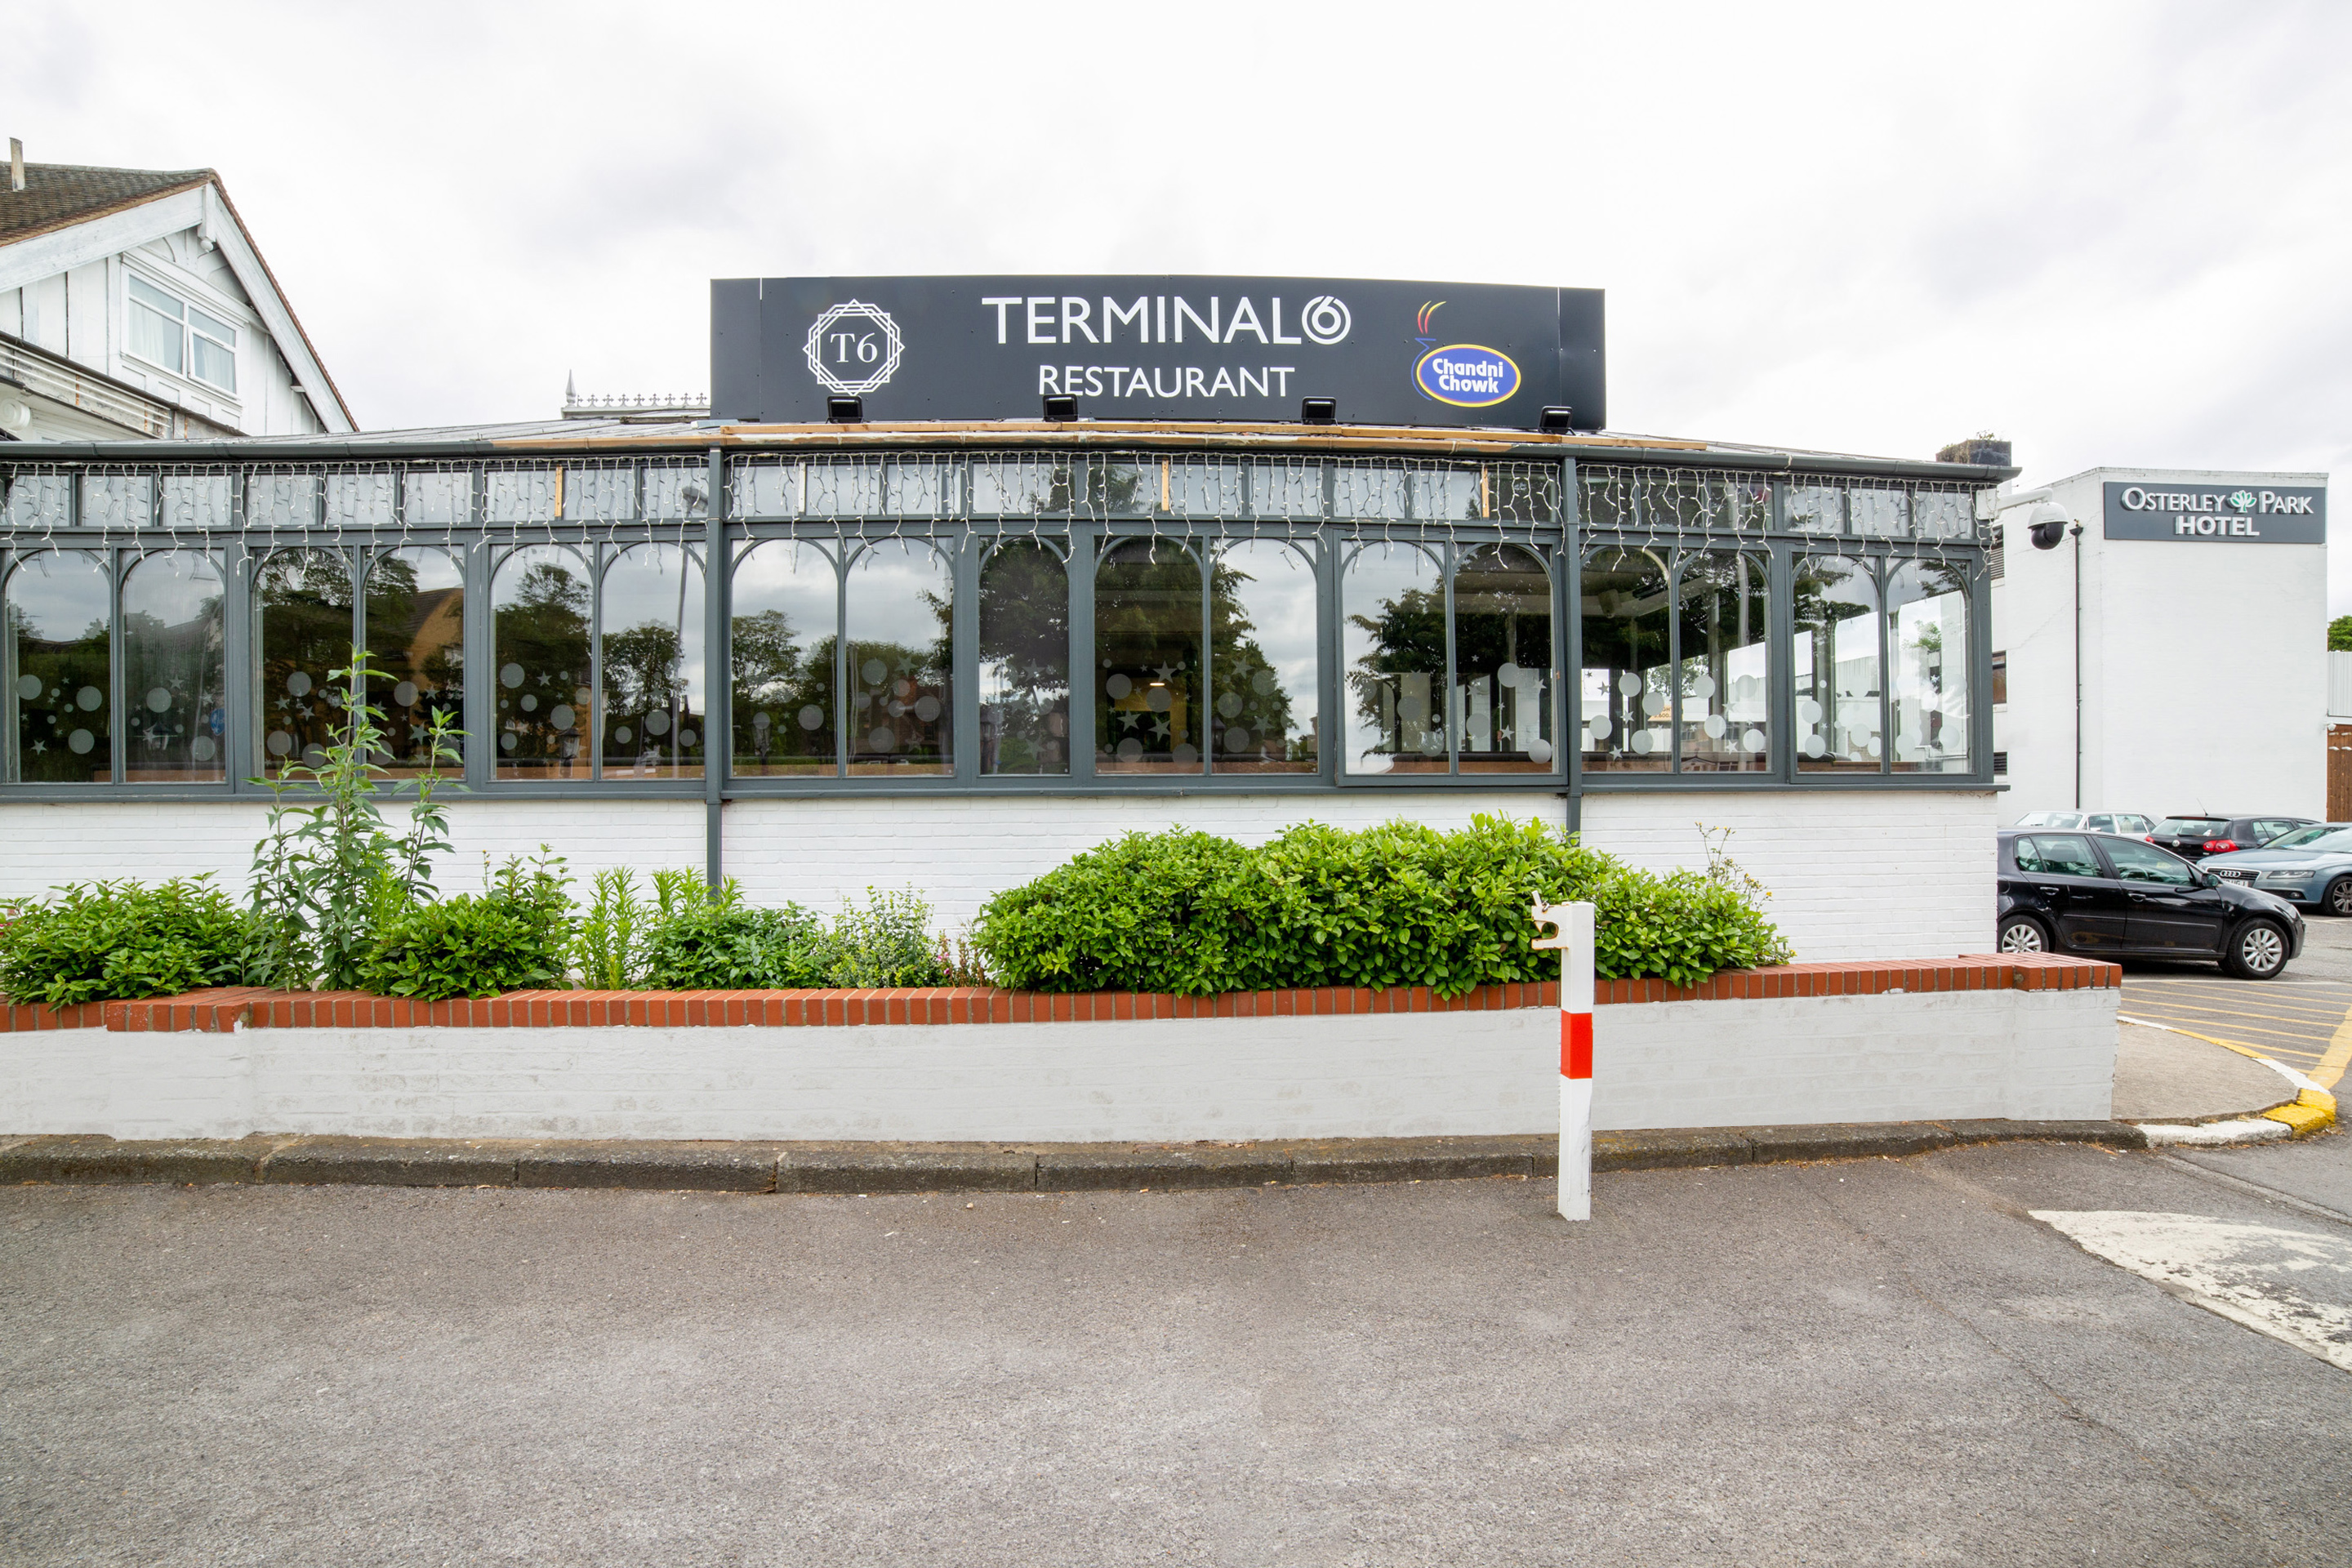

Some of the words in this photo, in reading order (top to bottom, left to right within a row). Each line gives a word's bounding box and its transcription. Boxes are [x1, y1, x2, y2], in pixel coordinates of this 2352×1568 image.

[830, 332, 878, 363] T6
[1432, 358, 1503, 378] Chandni
[1039, 364, 1295, 398] RESTAURANT
[1438, 374, 1499, 394] Chowk
[2121, 487, 2226, 512] OSTERLEY
[2257, 490, 2314, 514] PARK
[2175, 515, 2261, 537] HOTEL
